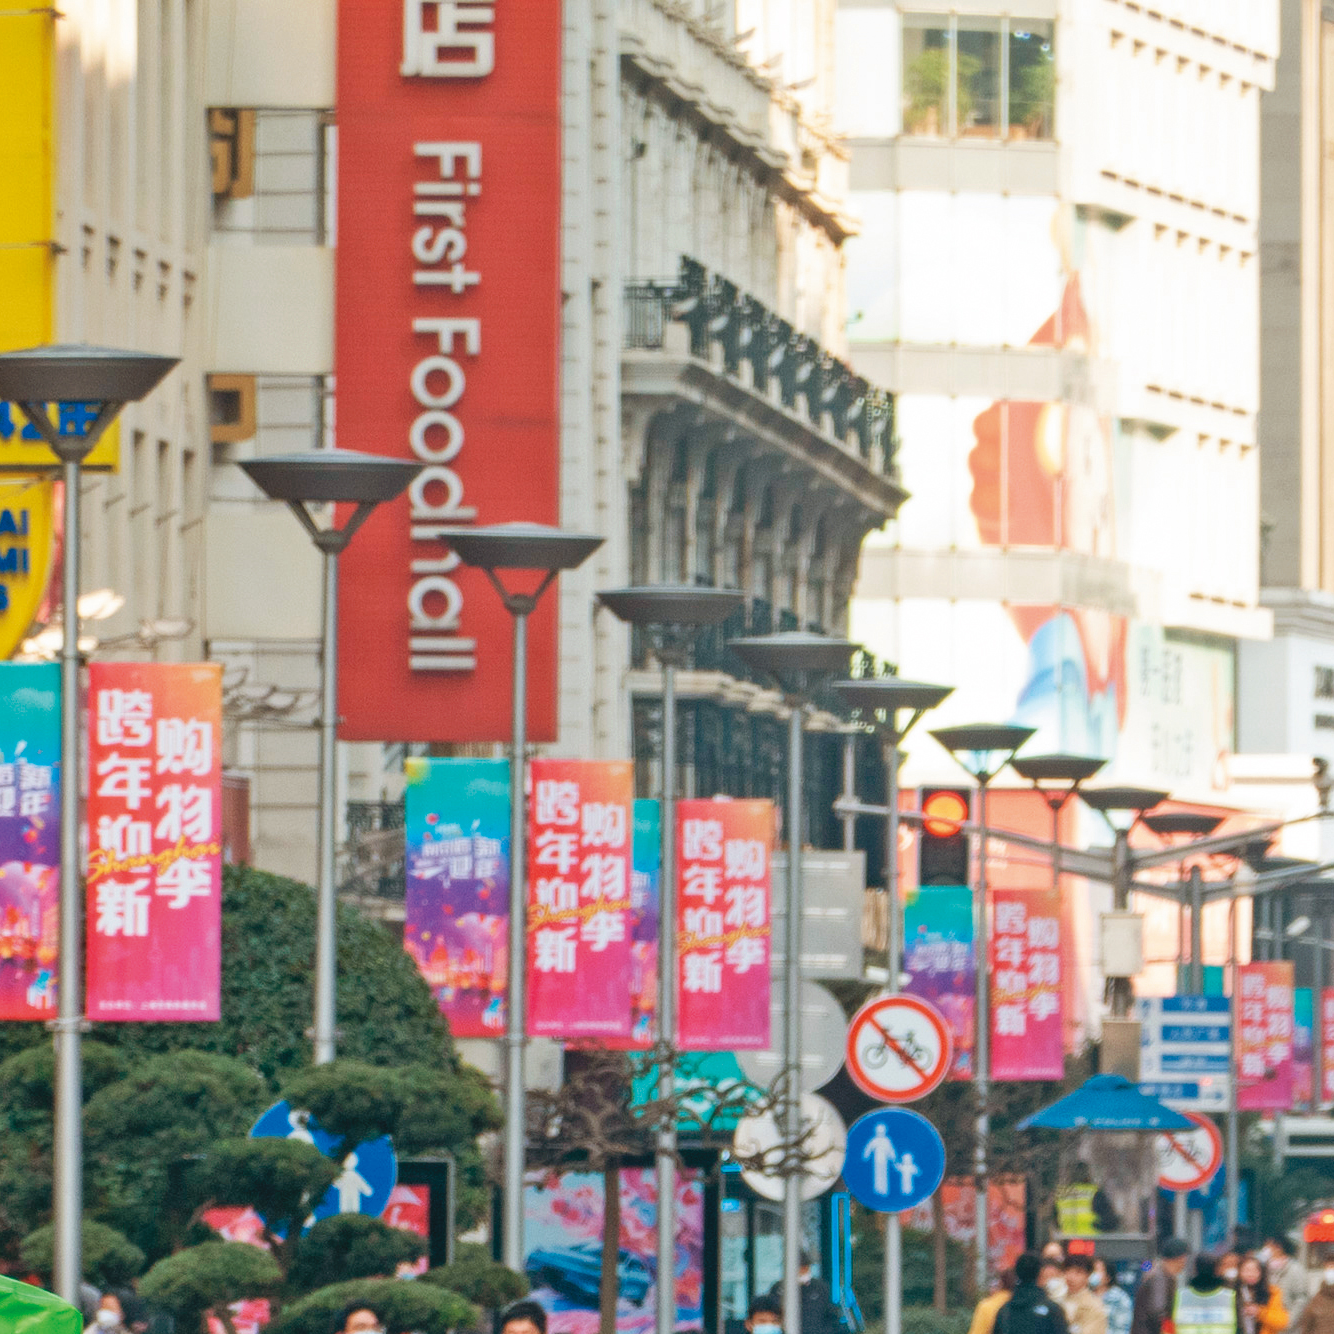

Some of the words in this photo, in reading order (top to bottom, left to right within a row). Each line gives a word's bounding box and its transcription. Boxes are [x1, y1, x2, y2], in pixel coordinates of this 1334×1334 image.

[412, 141, 481, 294] First
[408, 317, 481, 672] Foodhall
[97, 689, 153, 937] 跨年迎新
[155, 717, 213, 909] 购物季
